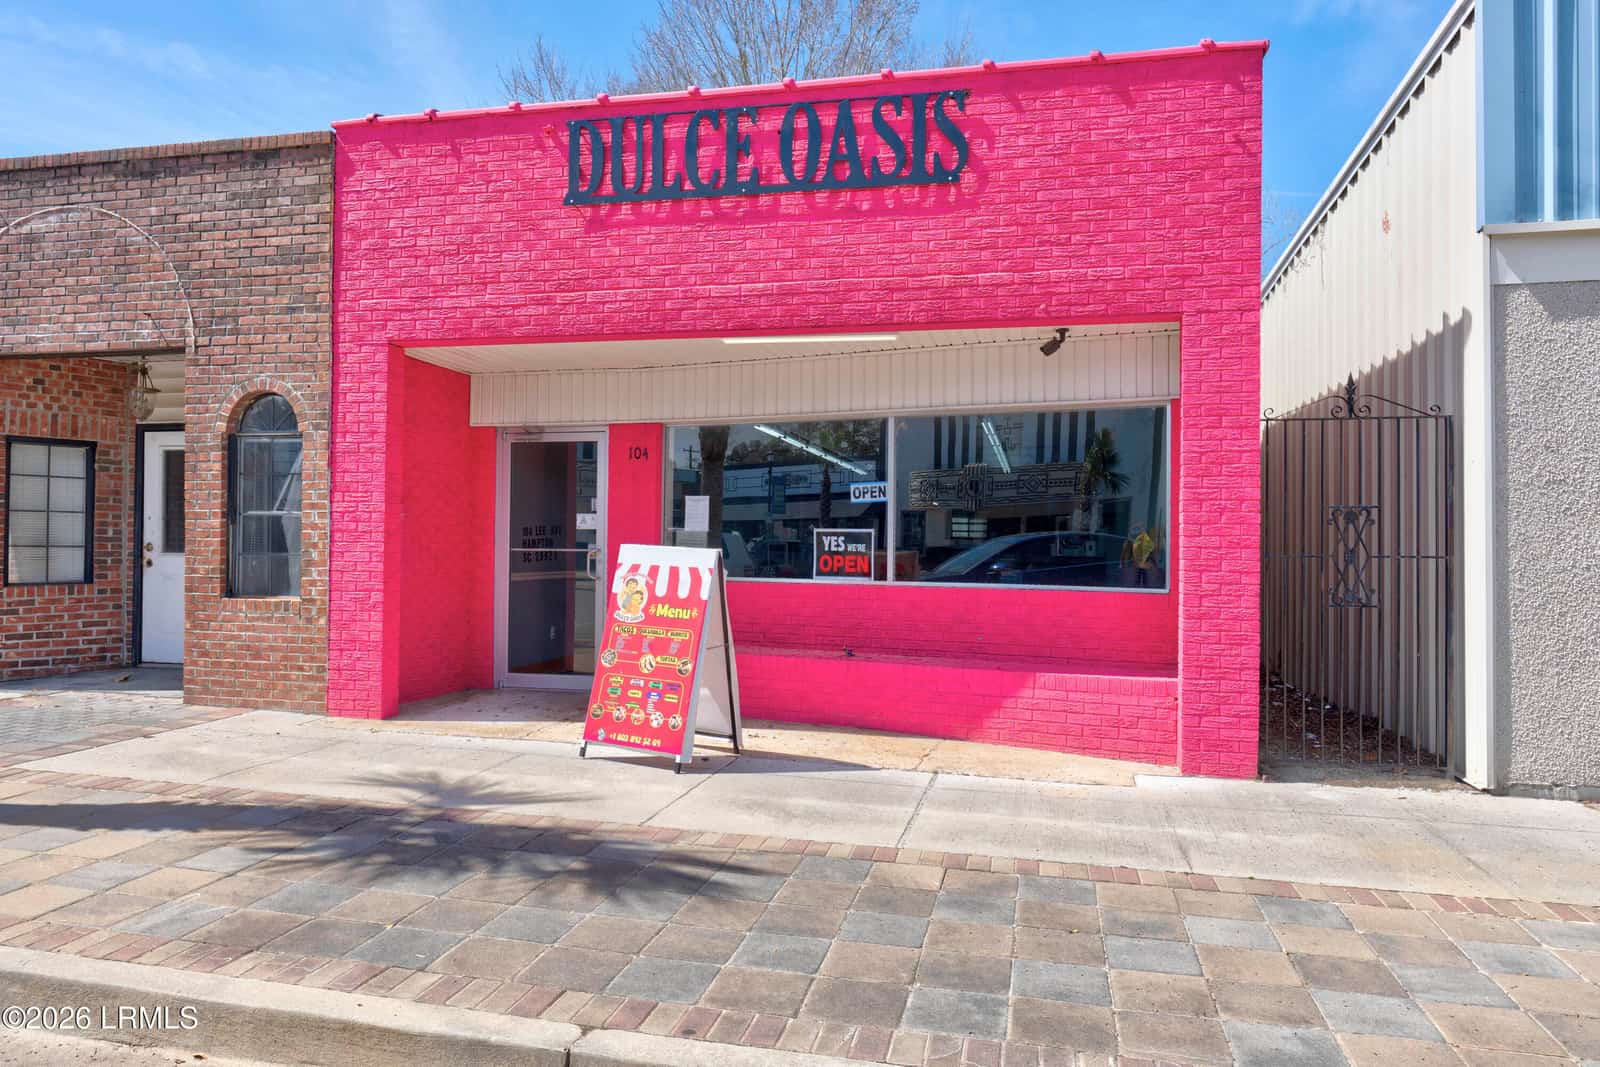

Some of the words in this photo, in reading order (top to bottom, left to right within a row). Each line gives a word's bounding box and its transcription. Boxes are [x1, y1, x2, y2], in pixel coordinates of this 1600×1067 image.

[566, 107, 758, 204] DULCE
[777, 89, 970, 190] OASIS
[628, 447, 649, 460] 104
[852, 485, 887, 499] OPEN
[822, 536, 845, 552] YES
[818, 554, 870, 574] OPEN
[656, 603, 692, 619] Menu
[616, 625, 635, 634] TACOS
